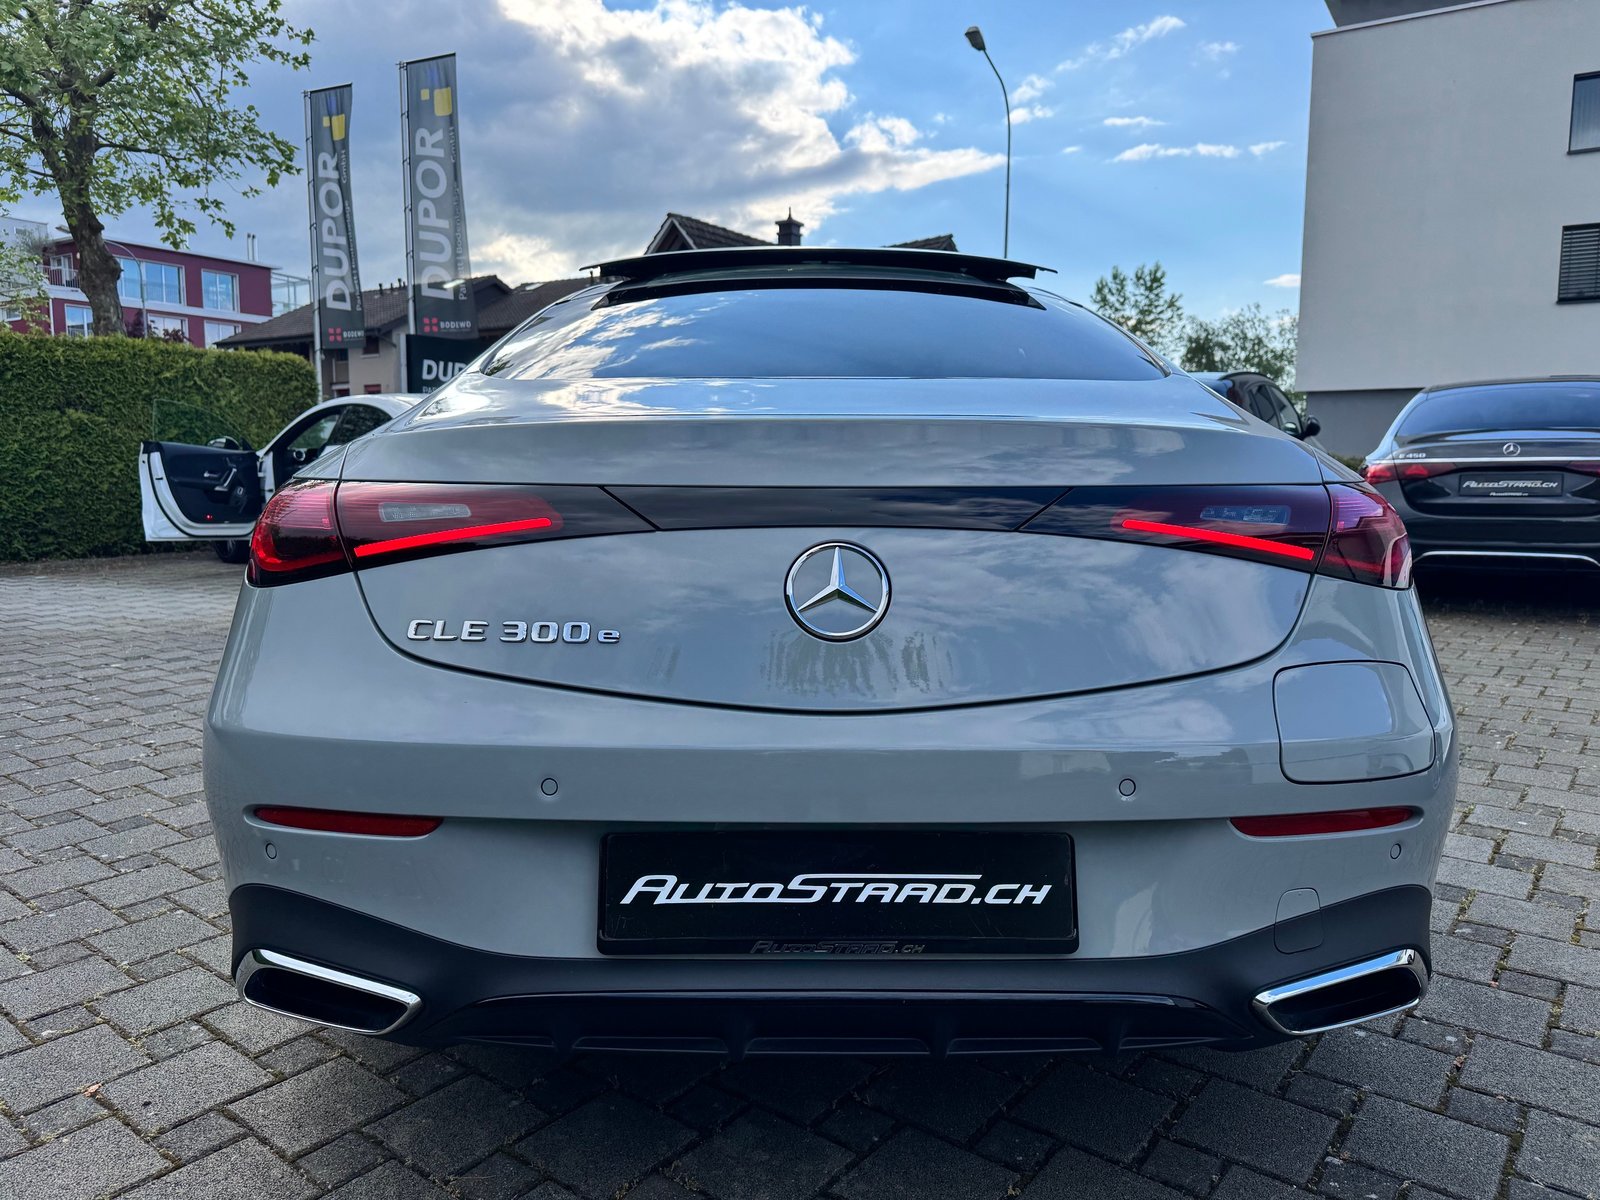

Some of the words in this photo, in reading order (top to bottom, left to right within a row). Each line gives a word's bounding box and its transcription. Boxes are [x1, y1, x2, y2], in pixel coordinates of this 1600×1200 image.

[317, 151, 352, 311] DUPOR
[415, 127, 454, 300] DUPOR
[407, 619, 489, 642] CLE
